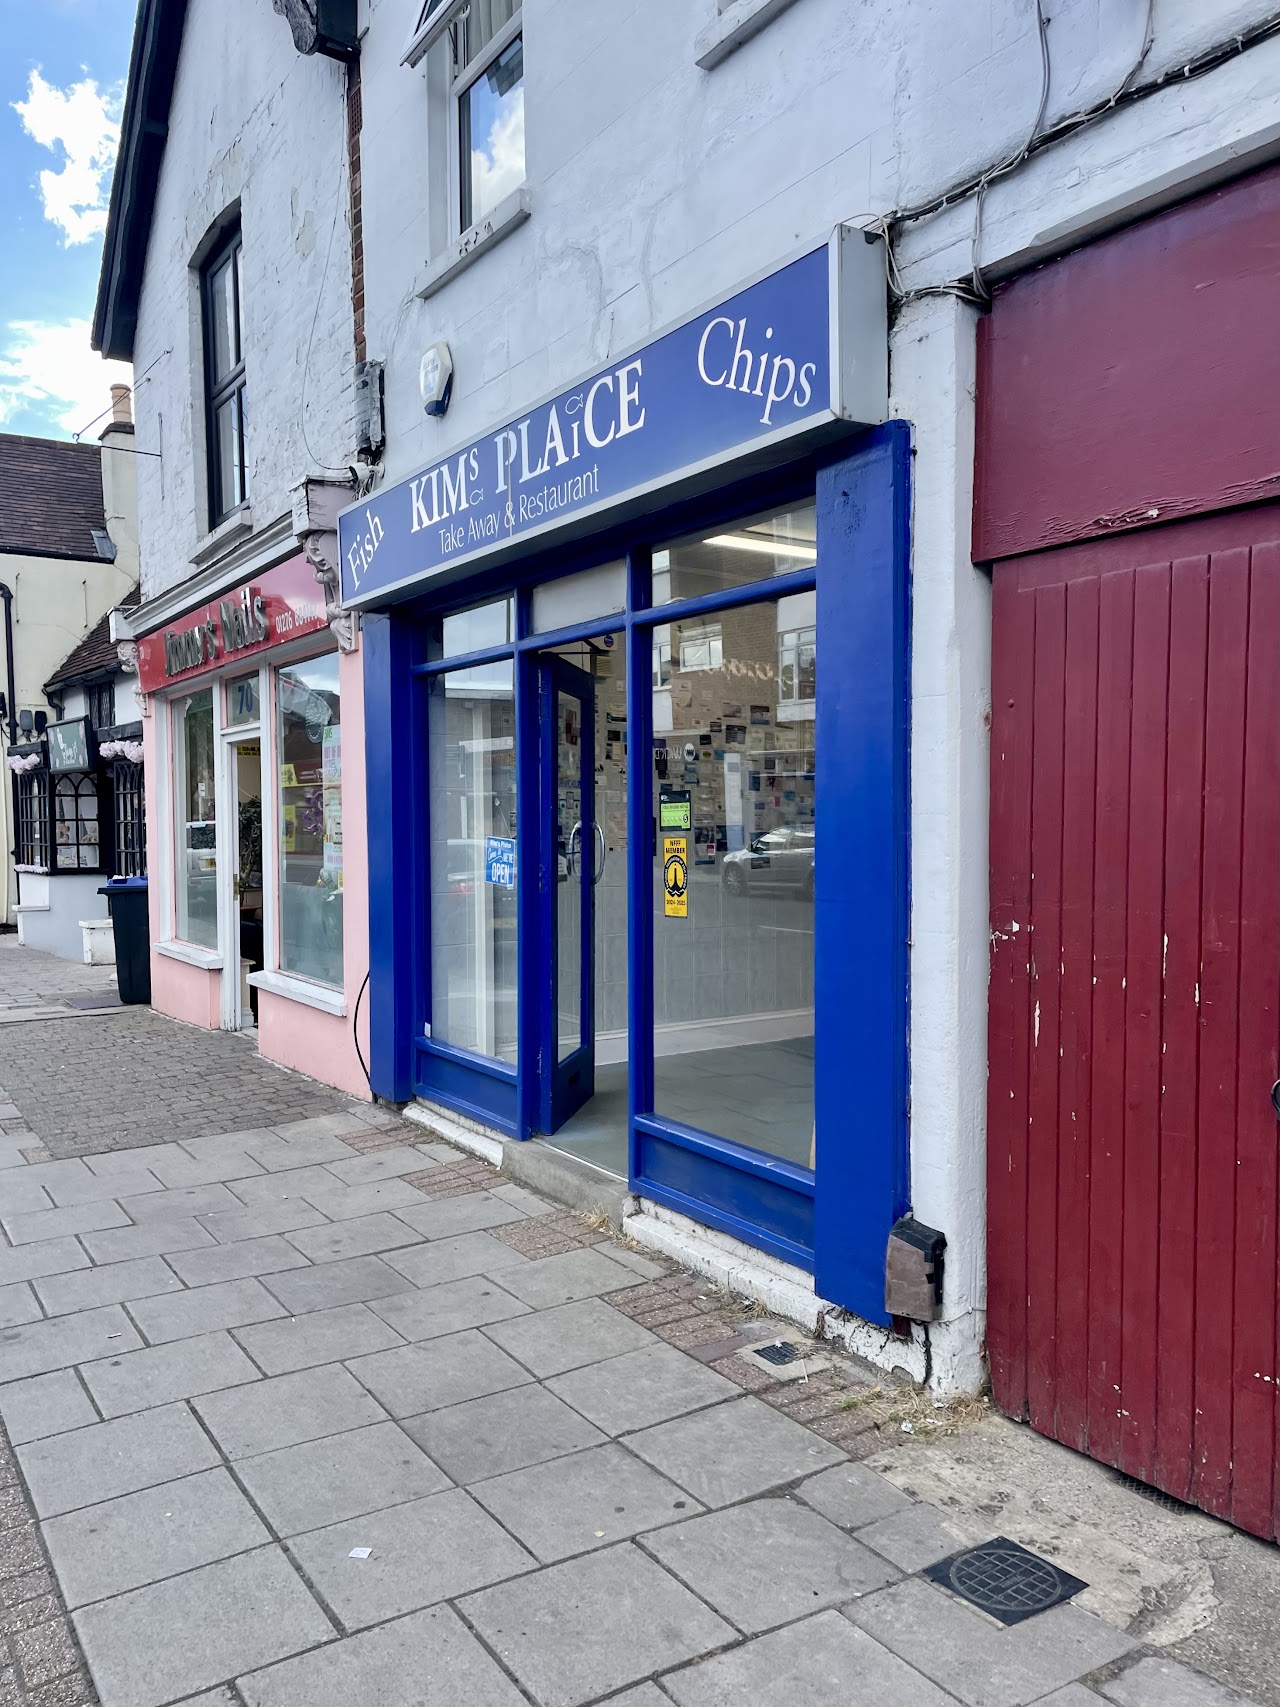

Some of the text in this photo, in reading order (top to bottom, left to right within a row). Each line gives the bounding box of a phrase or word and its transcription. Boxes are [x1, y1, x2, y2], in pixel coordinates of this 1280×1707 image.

[697, 317, 817, 426] Chips
[438, 463, 599, 554] Take Away & Restaurant
[347, 508, 385, 592] Fish
[219, 587, 268, 653] Nails
[275, 610, 293, 634] 01276
[237, 682, 254, 715] 70
[491, 862, 510, 885] OPEN
